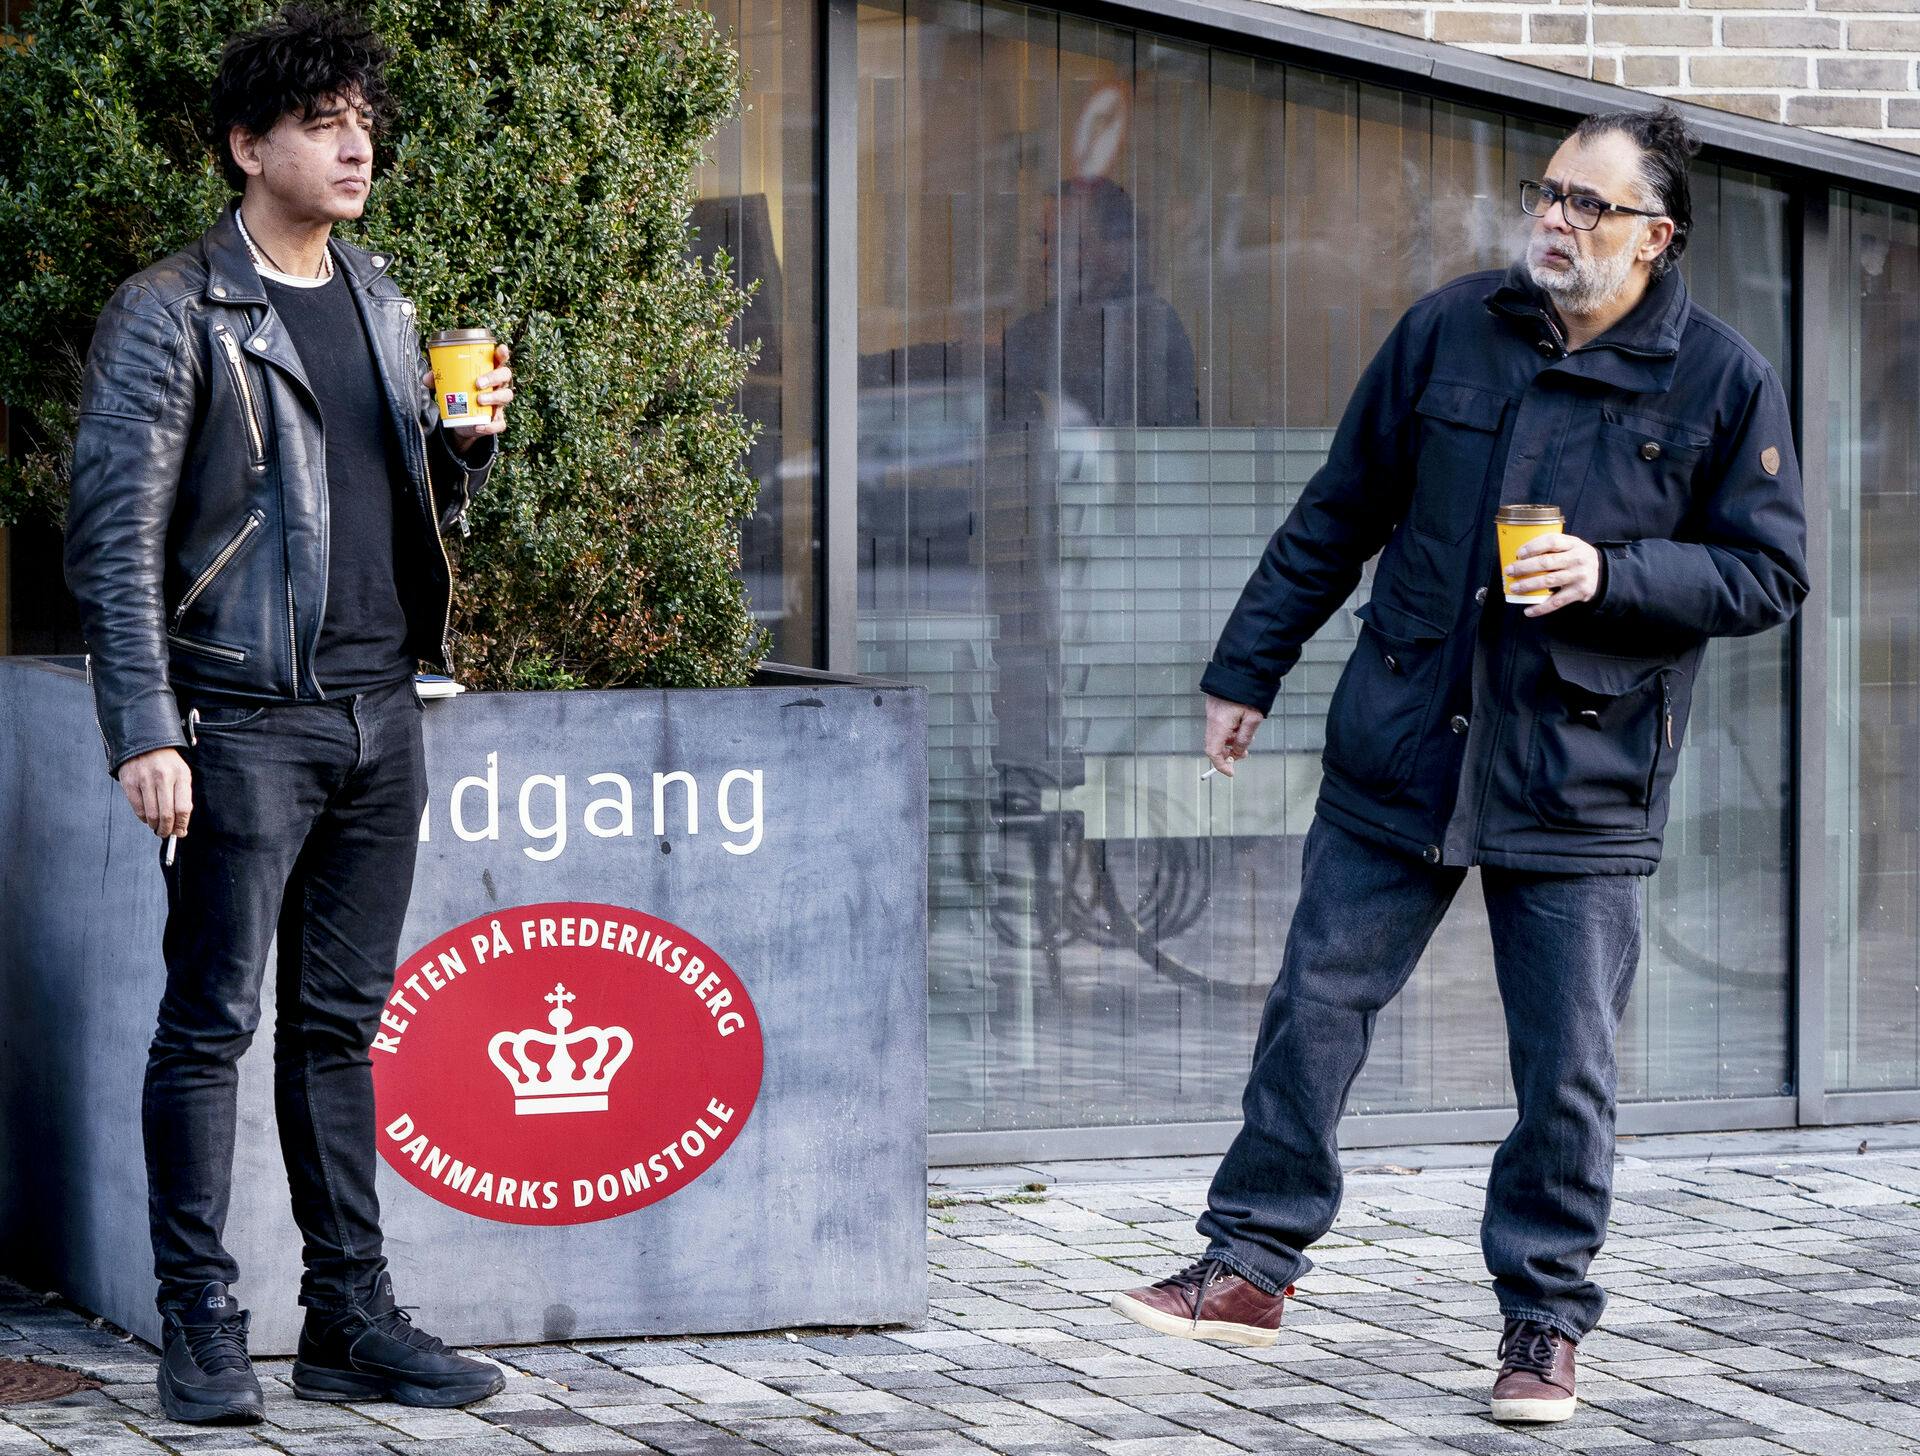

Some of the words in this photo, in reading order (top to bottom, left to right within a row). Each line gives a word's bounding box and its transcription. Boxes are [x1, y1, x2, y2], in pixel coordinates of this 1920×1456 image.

[371, 947, 467, 1054] RETTEN
[471, 919, 514, 965] PÅ
[521, 917, 745, 1037] FREDERIKSBERG
[385, 1113, 558, 1210] DANMARKS
[573, 1097, 734, 1210] DOMSTOLE
